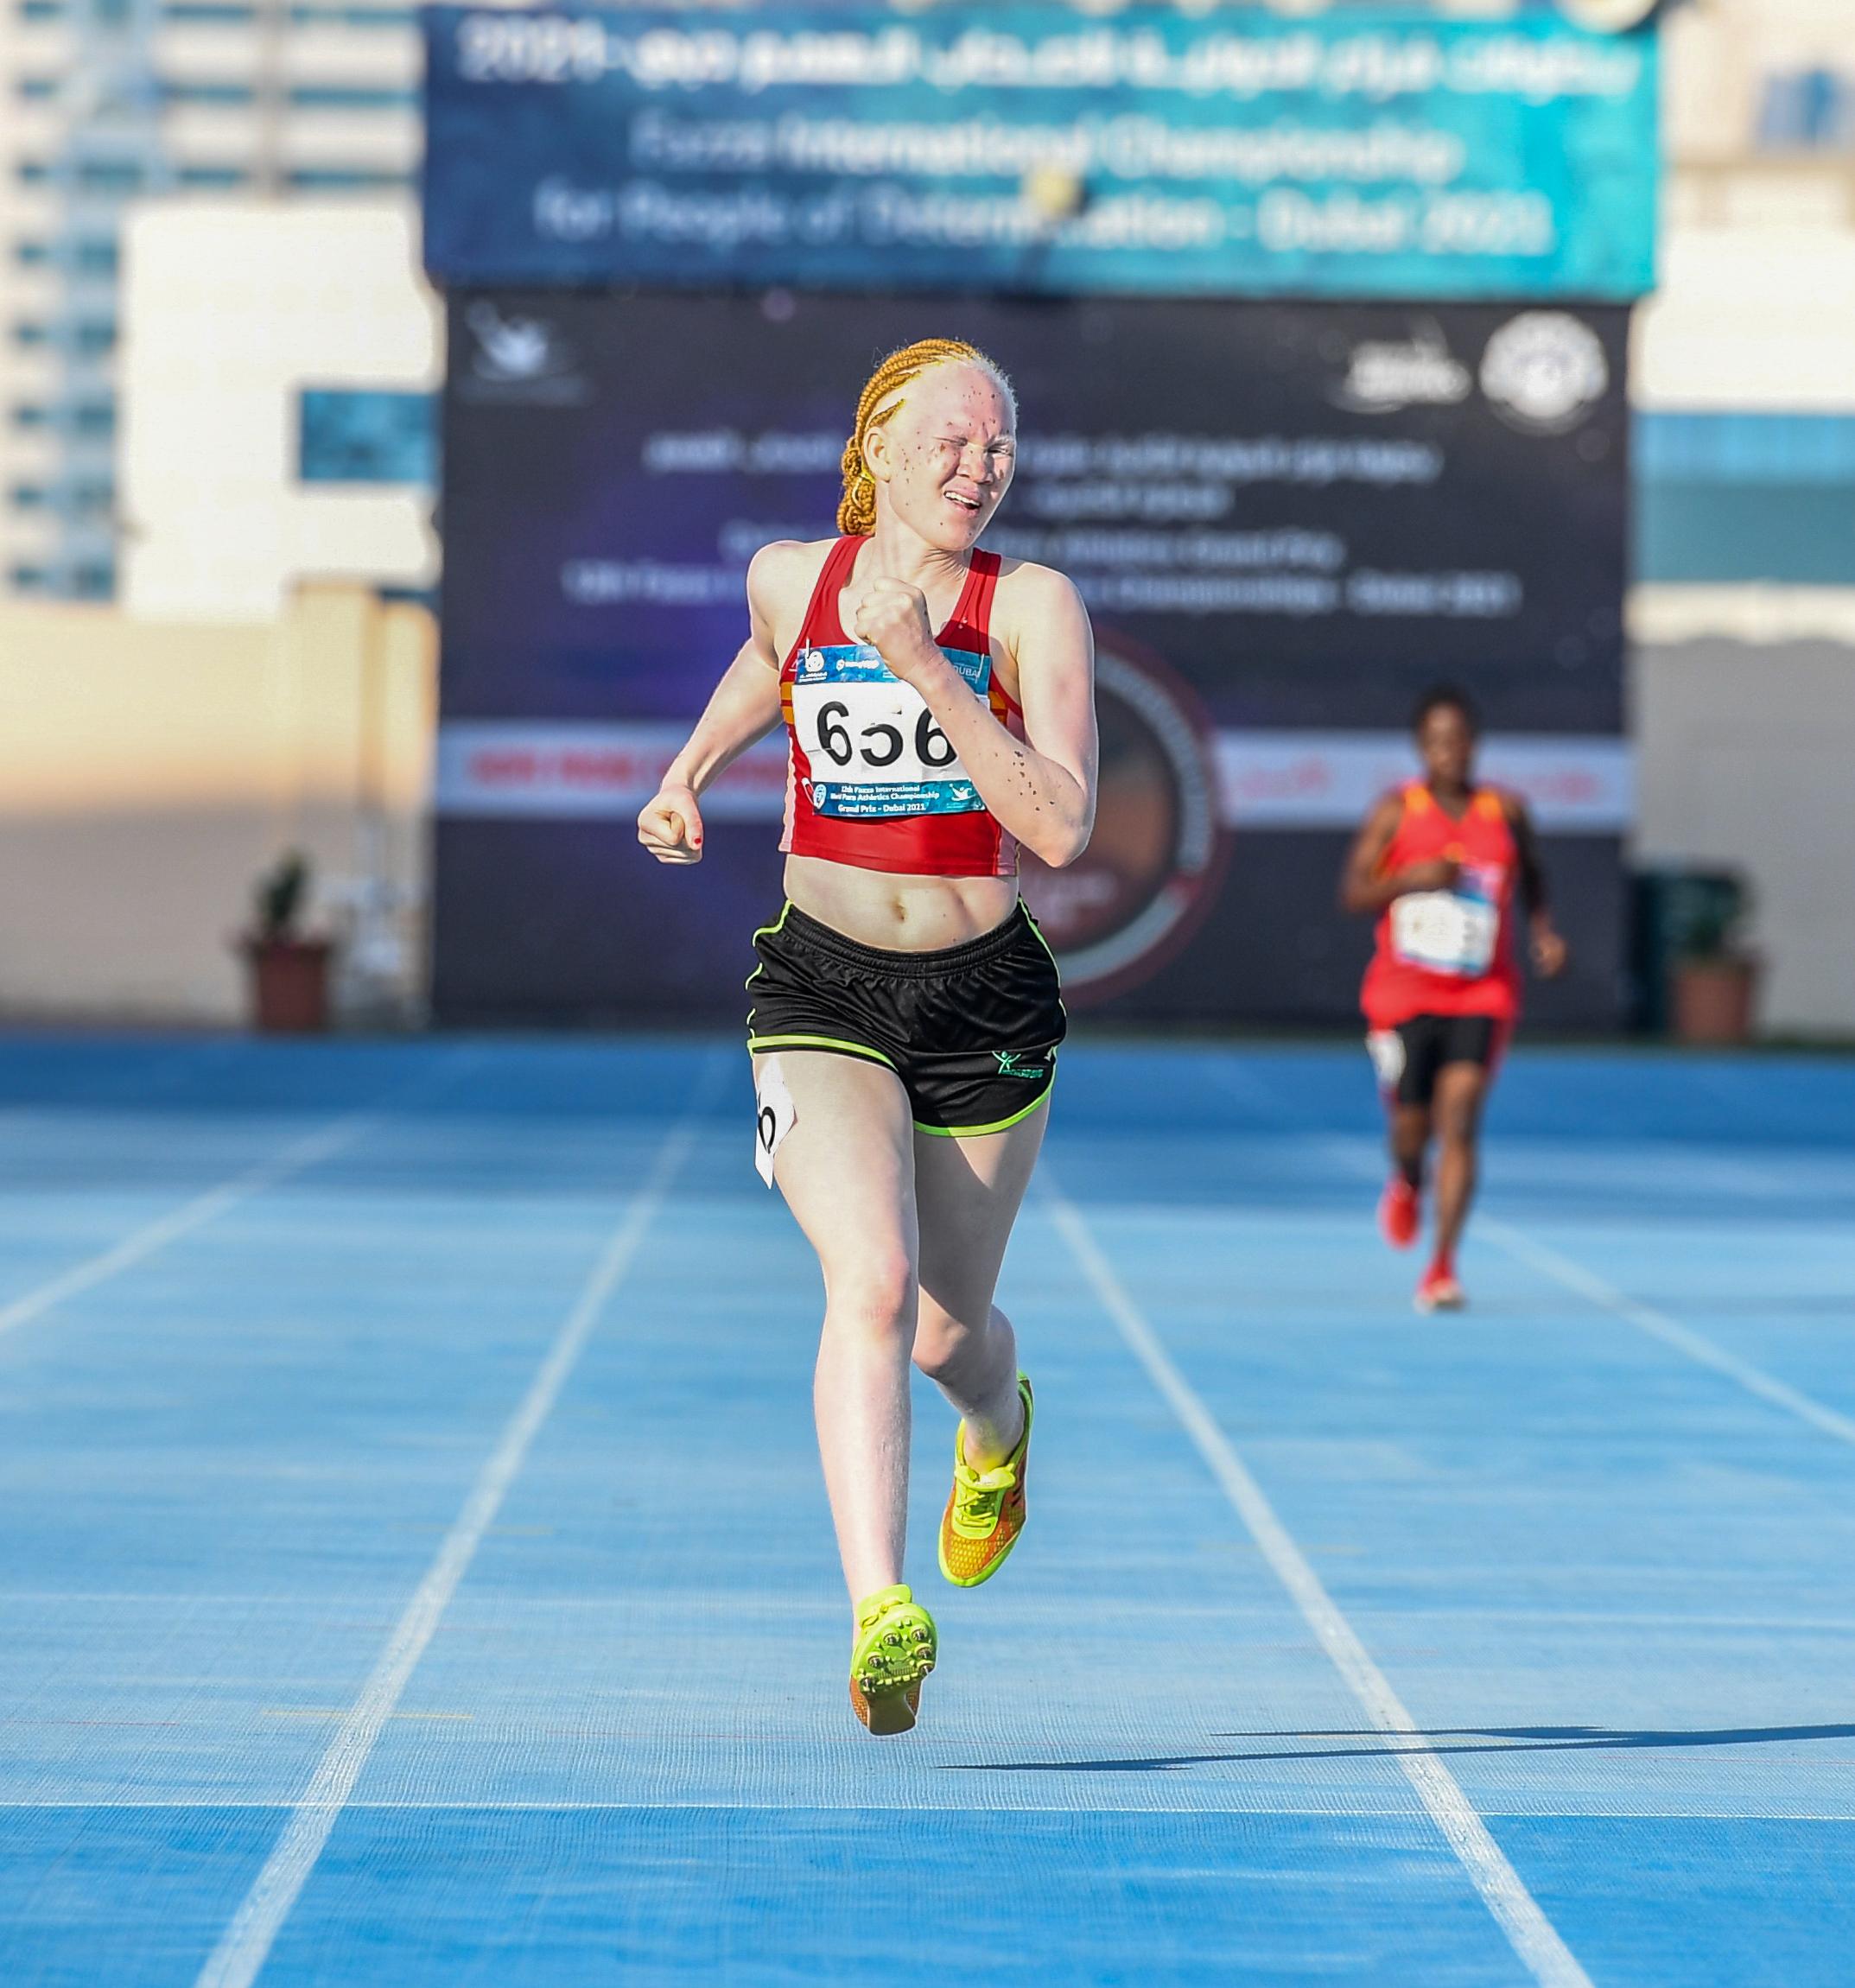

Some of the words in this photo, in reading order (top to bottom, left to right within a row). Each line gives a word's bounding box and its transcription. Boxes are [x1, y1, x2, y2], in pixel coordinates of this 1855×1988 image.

[774, 111, 1092, 176] International
[890, 791, 940, 800] Championship
[838, 803, 859, 813] Grand
[861, 804, 877, 813] Prix
[882, 803, 905, 812] Dubai
[906, 803, 926, 812] 2021
